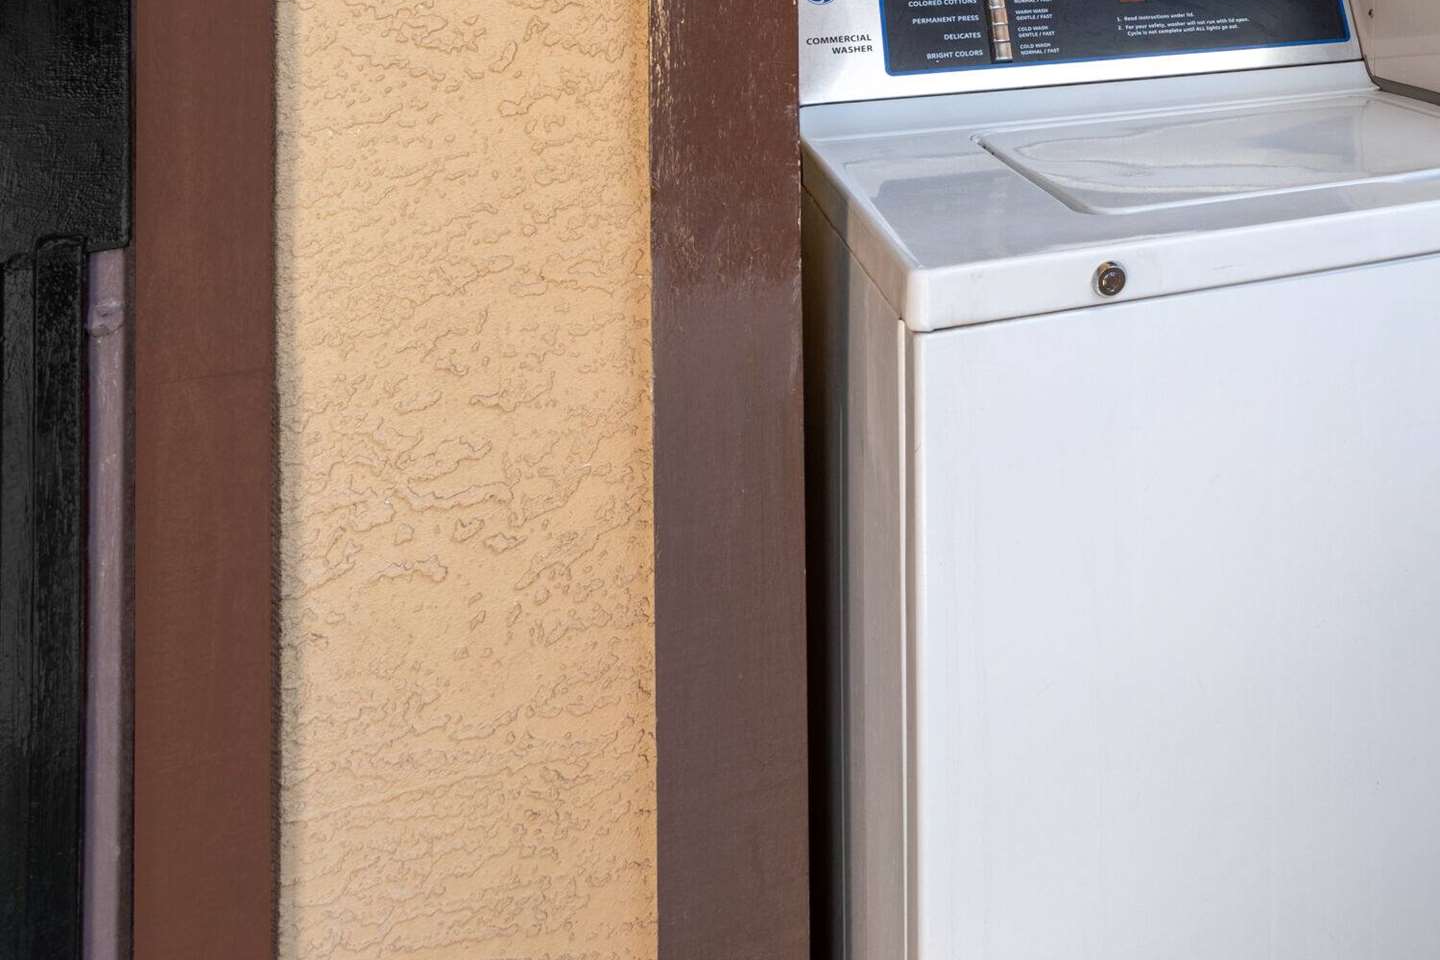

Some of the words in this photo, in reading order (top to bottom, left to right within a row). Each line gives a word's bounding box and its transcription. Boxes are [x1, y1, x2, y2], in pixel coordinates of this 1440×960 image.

[908, 0, 942, 7] COLORED
[912, 16, 956, 25] PERMANENT
[957, 14, 980, 22] PRESS
[806, 33, 872, 45] COMMERCIAL
[943, 32, 982, 40] DELICATES
[831, 45, 873, 55] WASHER
[926, 52, 953, 60] BRIGHT
[954, 49, 984, 58] COLORS
